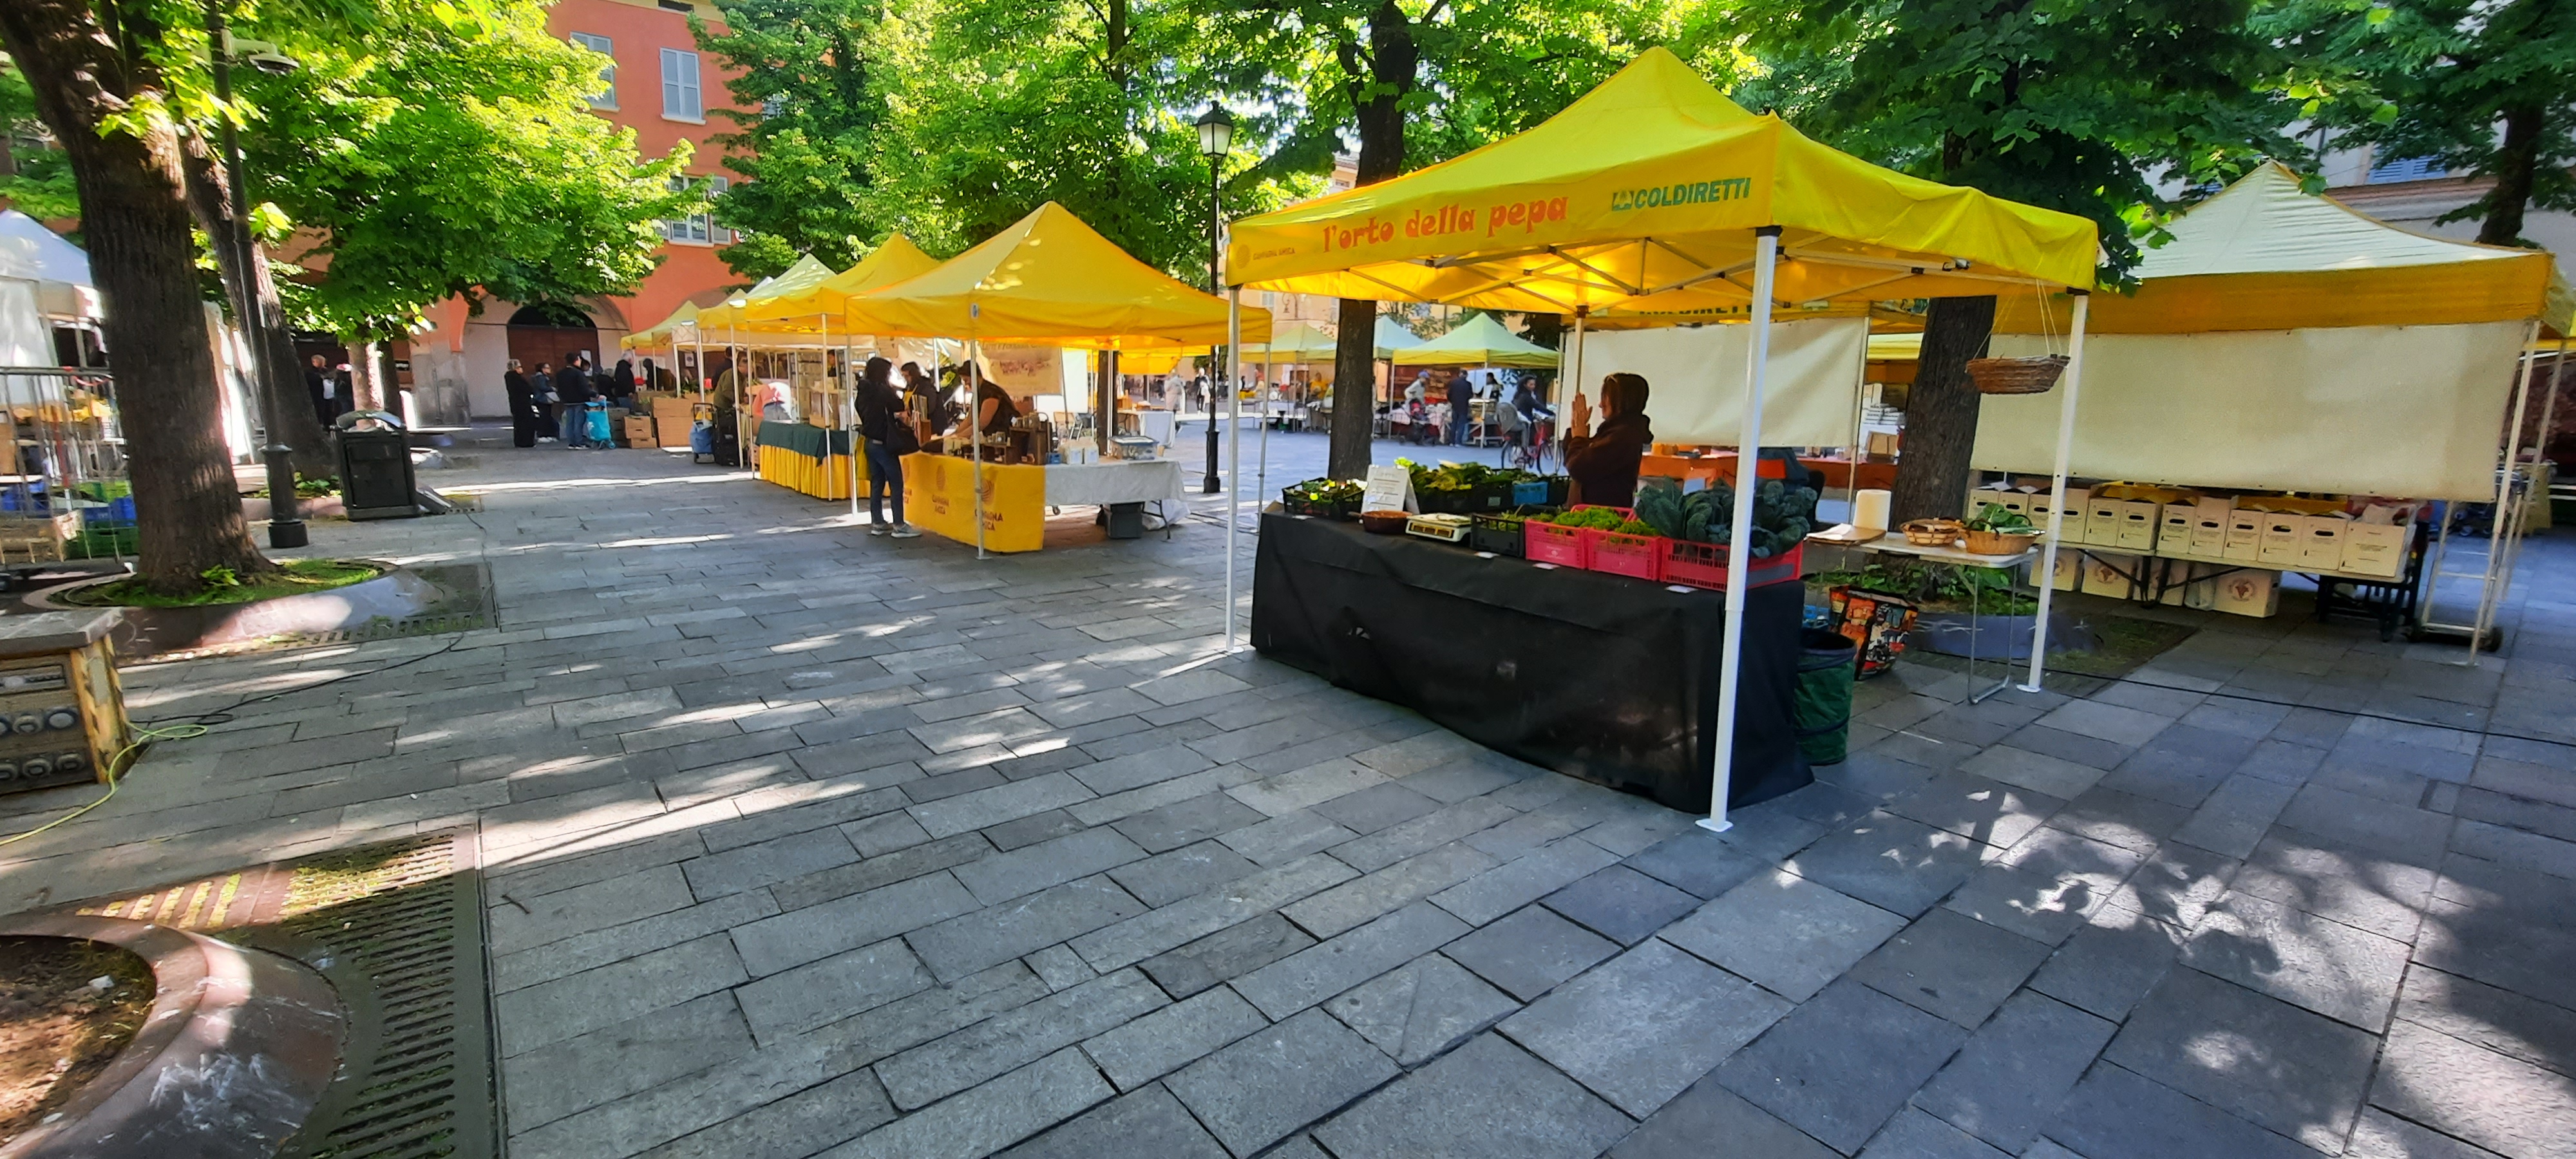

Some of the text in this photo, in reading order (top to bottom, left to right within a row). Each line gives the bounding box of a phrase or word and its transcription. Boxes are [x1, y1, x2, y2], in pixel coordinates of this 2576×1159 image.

[1634, 177, 1752, 209] COLDIRETTI
[1322, 196, 1569, 253] l'orto della pepa
